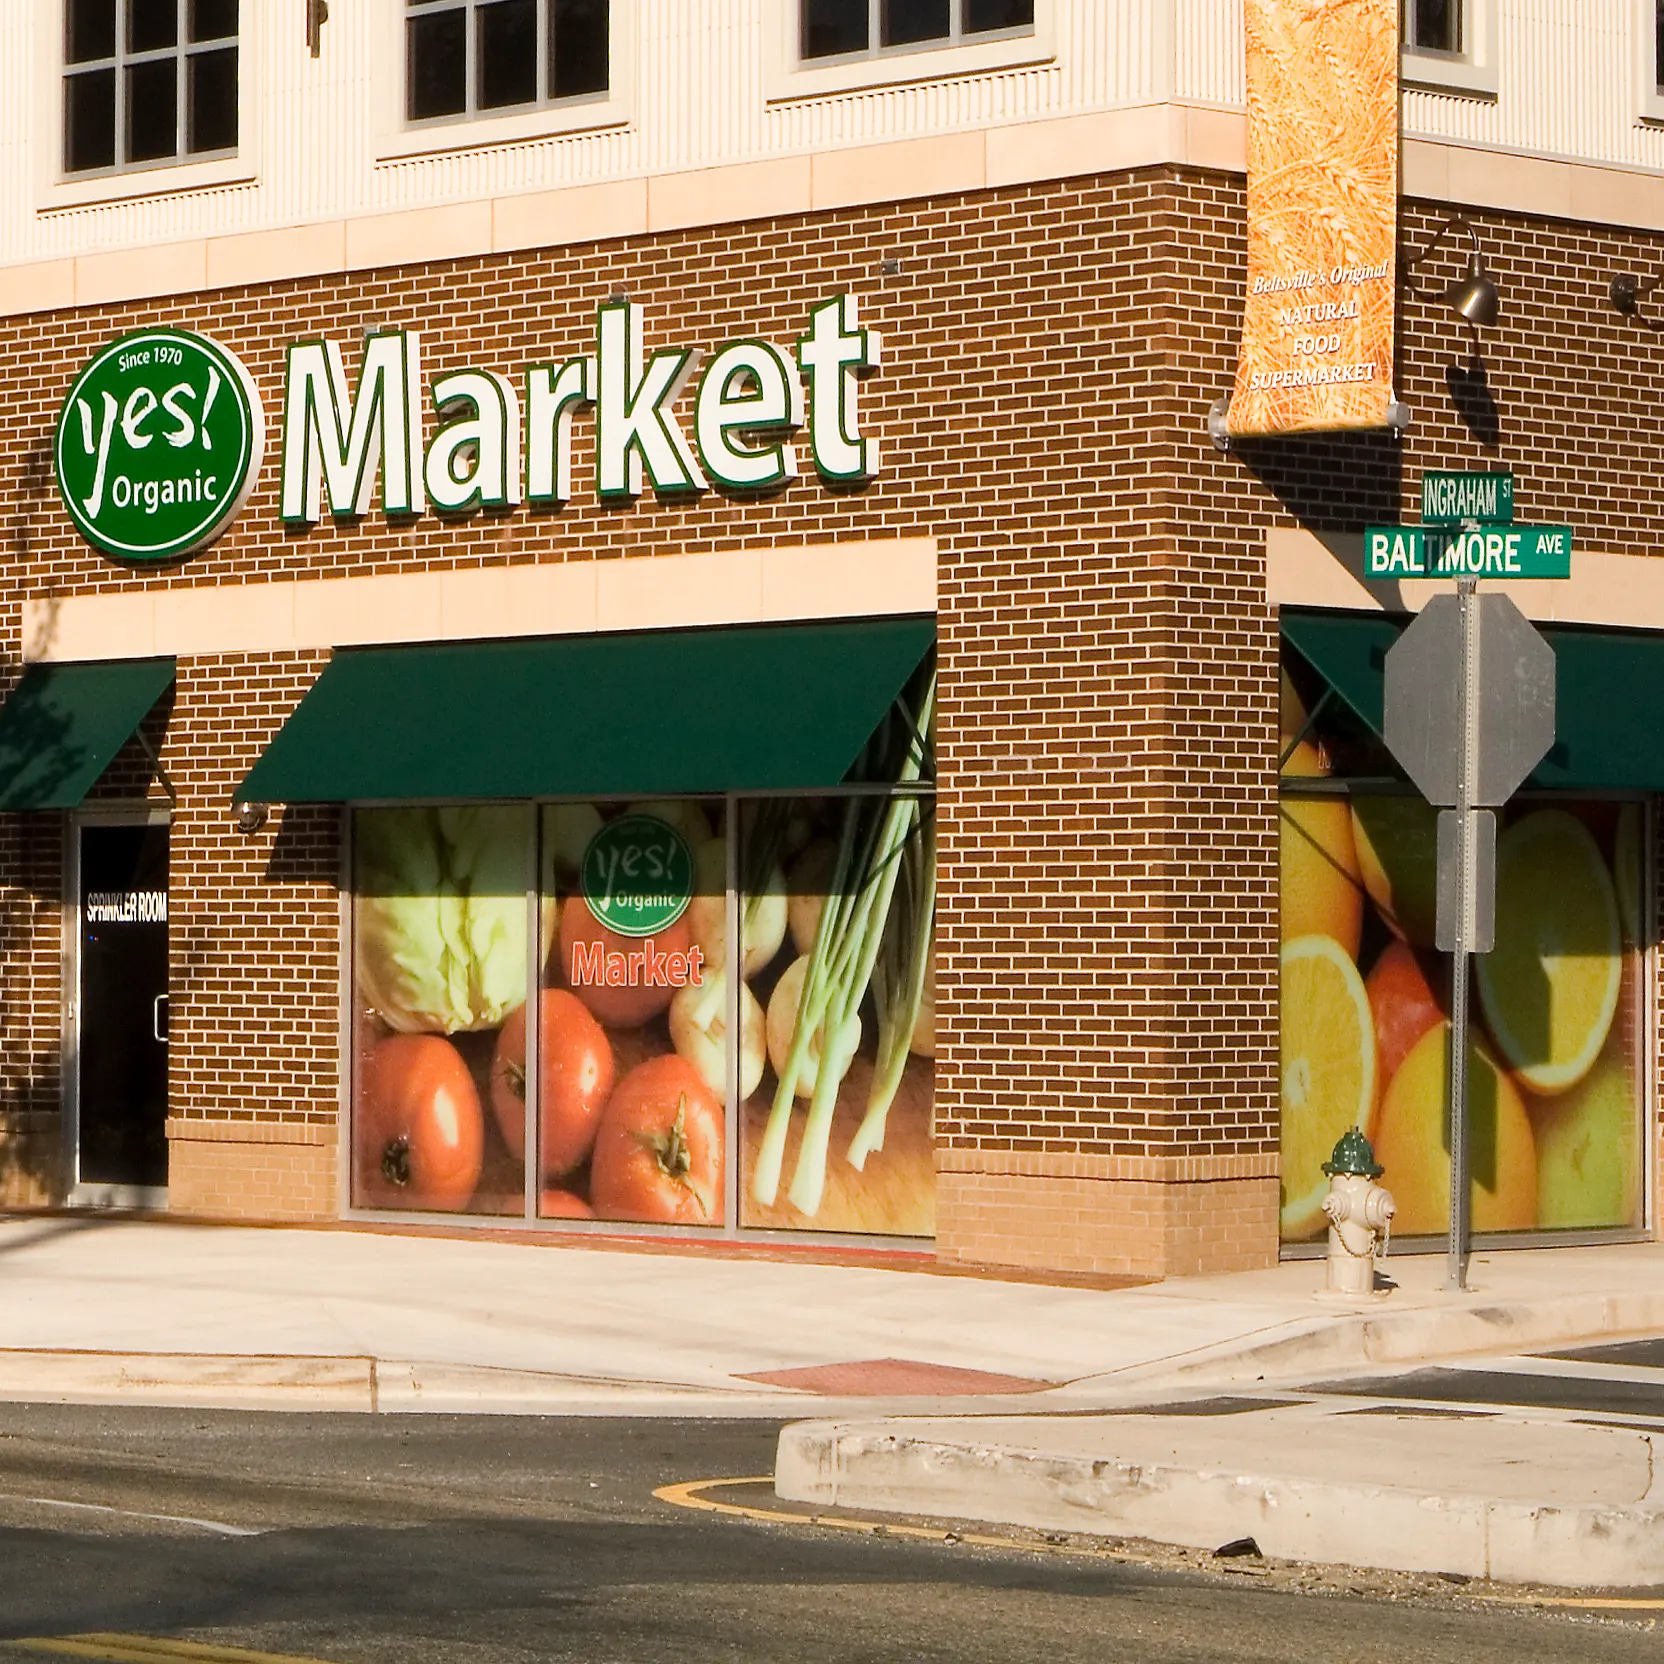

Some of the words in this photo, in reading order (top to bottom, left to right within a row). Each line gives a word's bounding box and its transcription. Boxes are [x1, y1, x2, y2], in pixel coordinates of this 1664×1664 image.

[1252, 269, 1327, 295] Beltsville's
[1330, 259, 1389, 286] Original
[1278, 300, 1359, 327] NATURAL
[118, 349, 150, 373] Since
[153, 347, 184, 366] 1970
[1292, 334, 1342, 357] FOOD
[1249, 362, 1377, 392] SUPERMARKET
[279, 293, 882, 524] Market
[77, 365, 222, 520] yes!
[112, 468, 218, 515] Organic
[1423, 478, 1497, 517] INGRAHAM
[1503, 479, 1512, 498] ST
[1372, 534, 1522, 573] BALTIMORE
[1536, 534, 1564, 555] AVE
[596, 835, 678, 913] yes!
[87, 892, 137, 923] SPRINKLER
[138, 891, 167, 923] ROOM
[616, 889, 677, 912] Organic
[571, 939, 704, 988] Market
